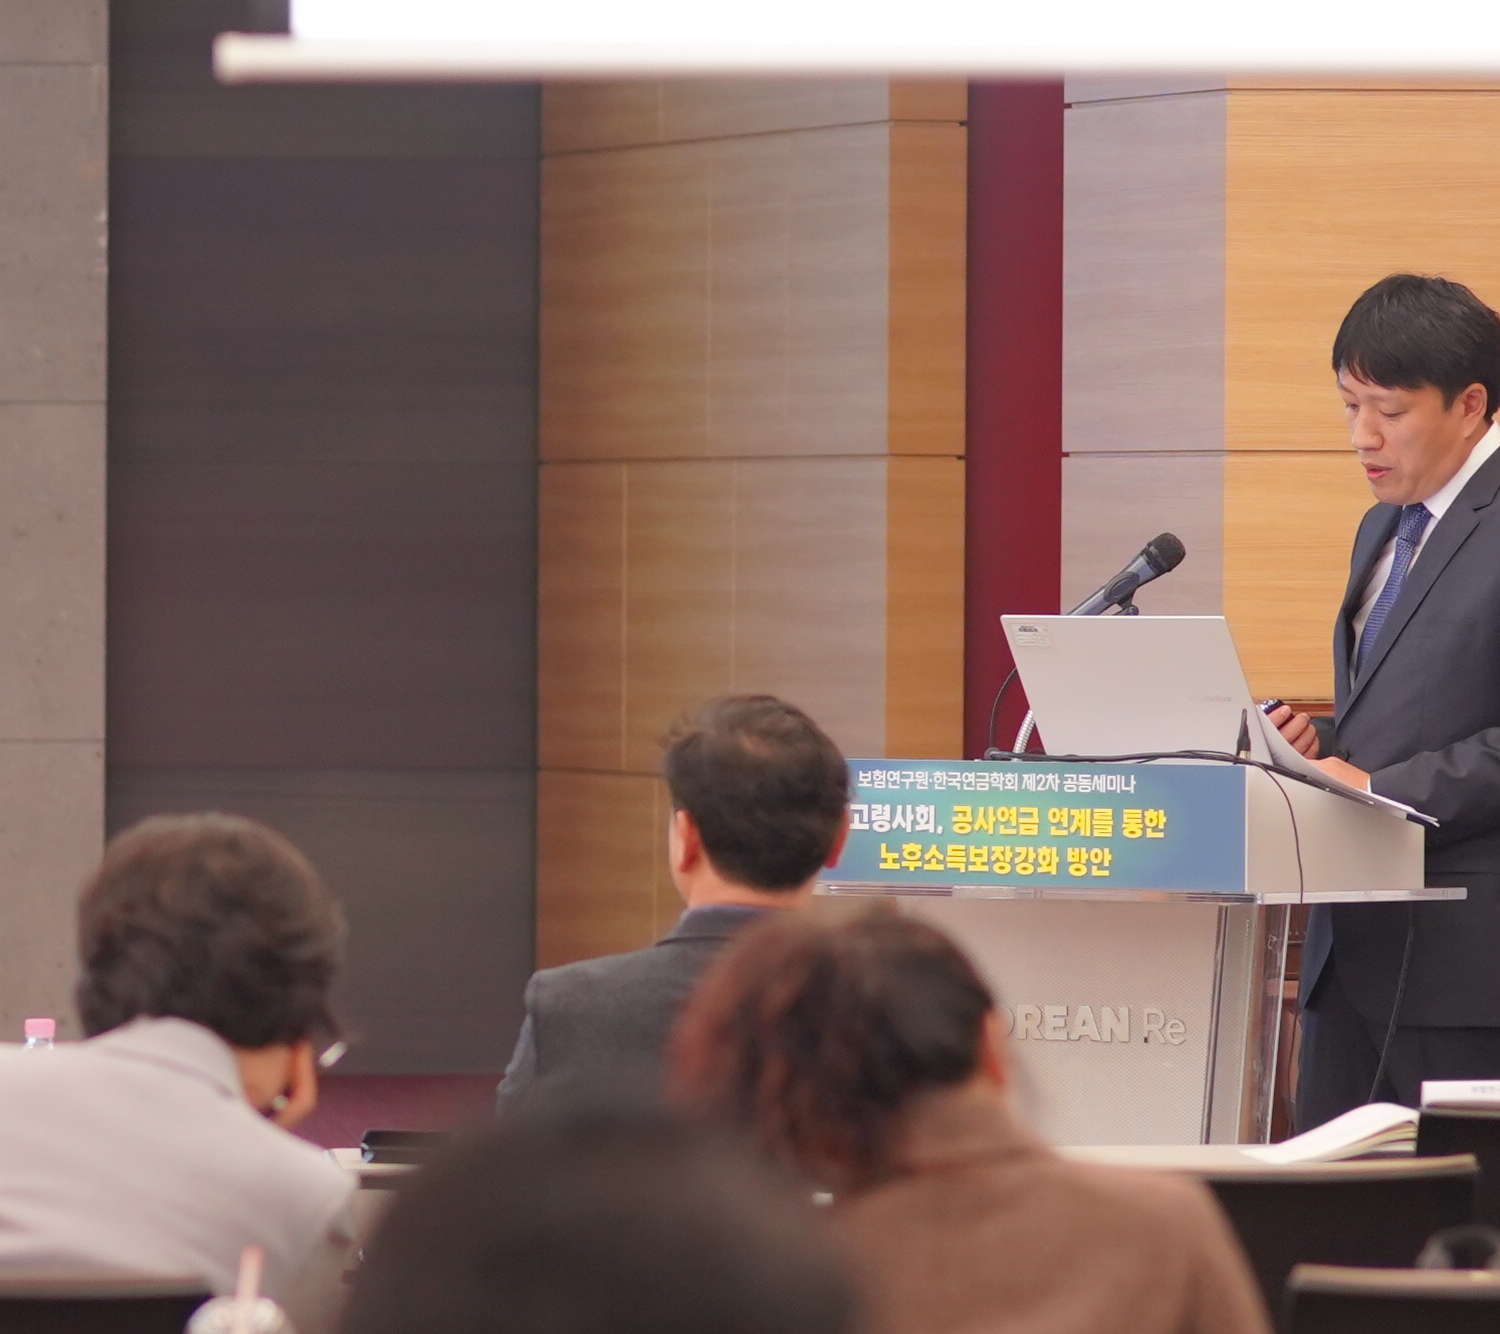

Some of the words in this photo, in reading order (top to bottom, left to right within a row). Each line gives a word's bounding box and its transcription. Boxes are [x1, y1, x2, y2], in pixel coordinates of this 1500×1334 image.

[858, 769, 1019, 792] 보험연구원·한국연금학회
[1021, 773, 1060, 794] 제2차
[1062, 774, 1137, 795] 공동세미나
[850, 803, 944, 835] 고령사회,
[951, 804, 1041, 836] 공사연금
[1047, 807, 1115, 838] 연계를
[1120, 808, 1168, 839] 통한
[878, 842, 1060, 876] 노후소득보장강화
[1066, 846, 1113, 877] 방안
[1006, 1004, 1132, 1043] REAN
[1143, 1007, 1188, 1046] Re
